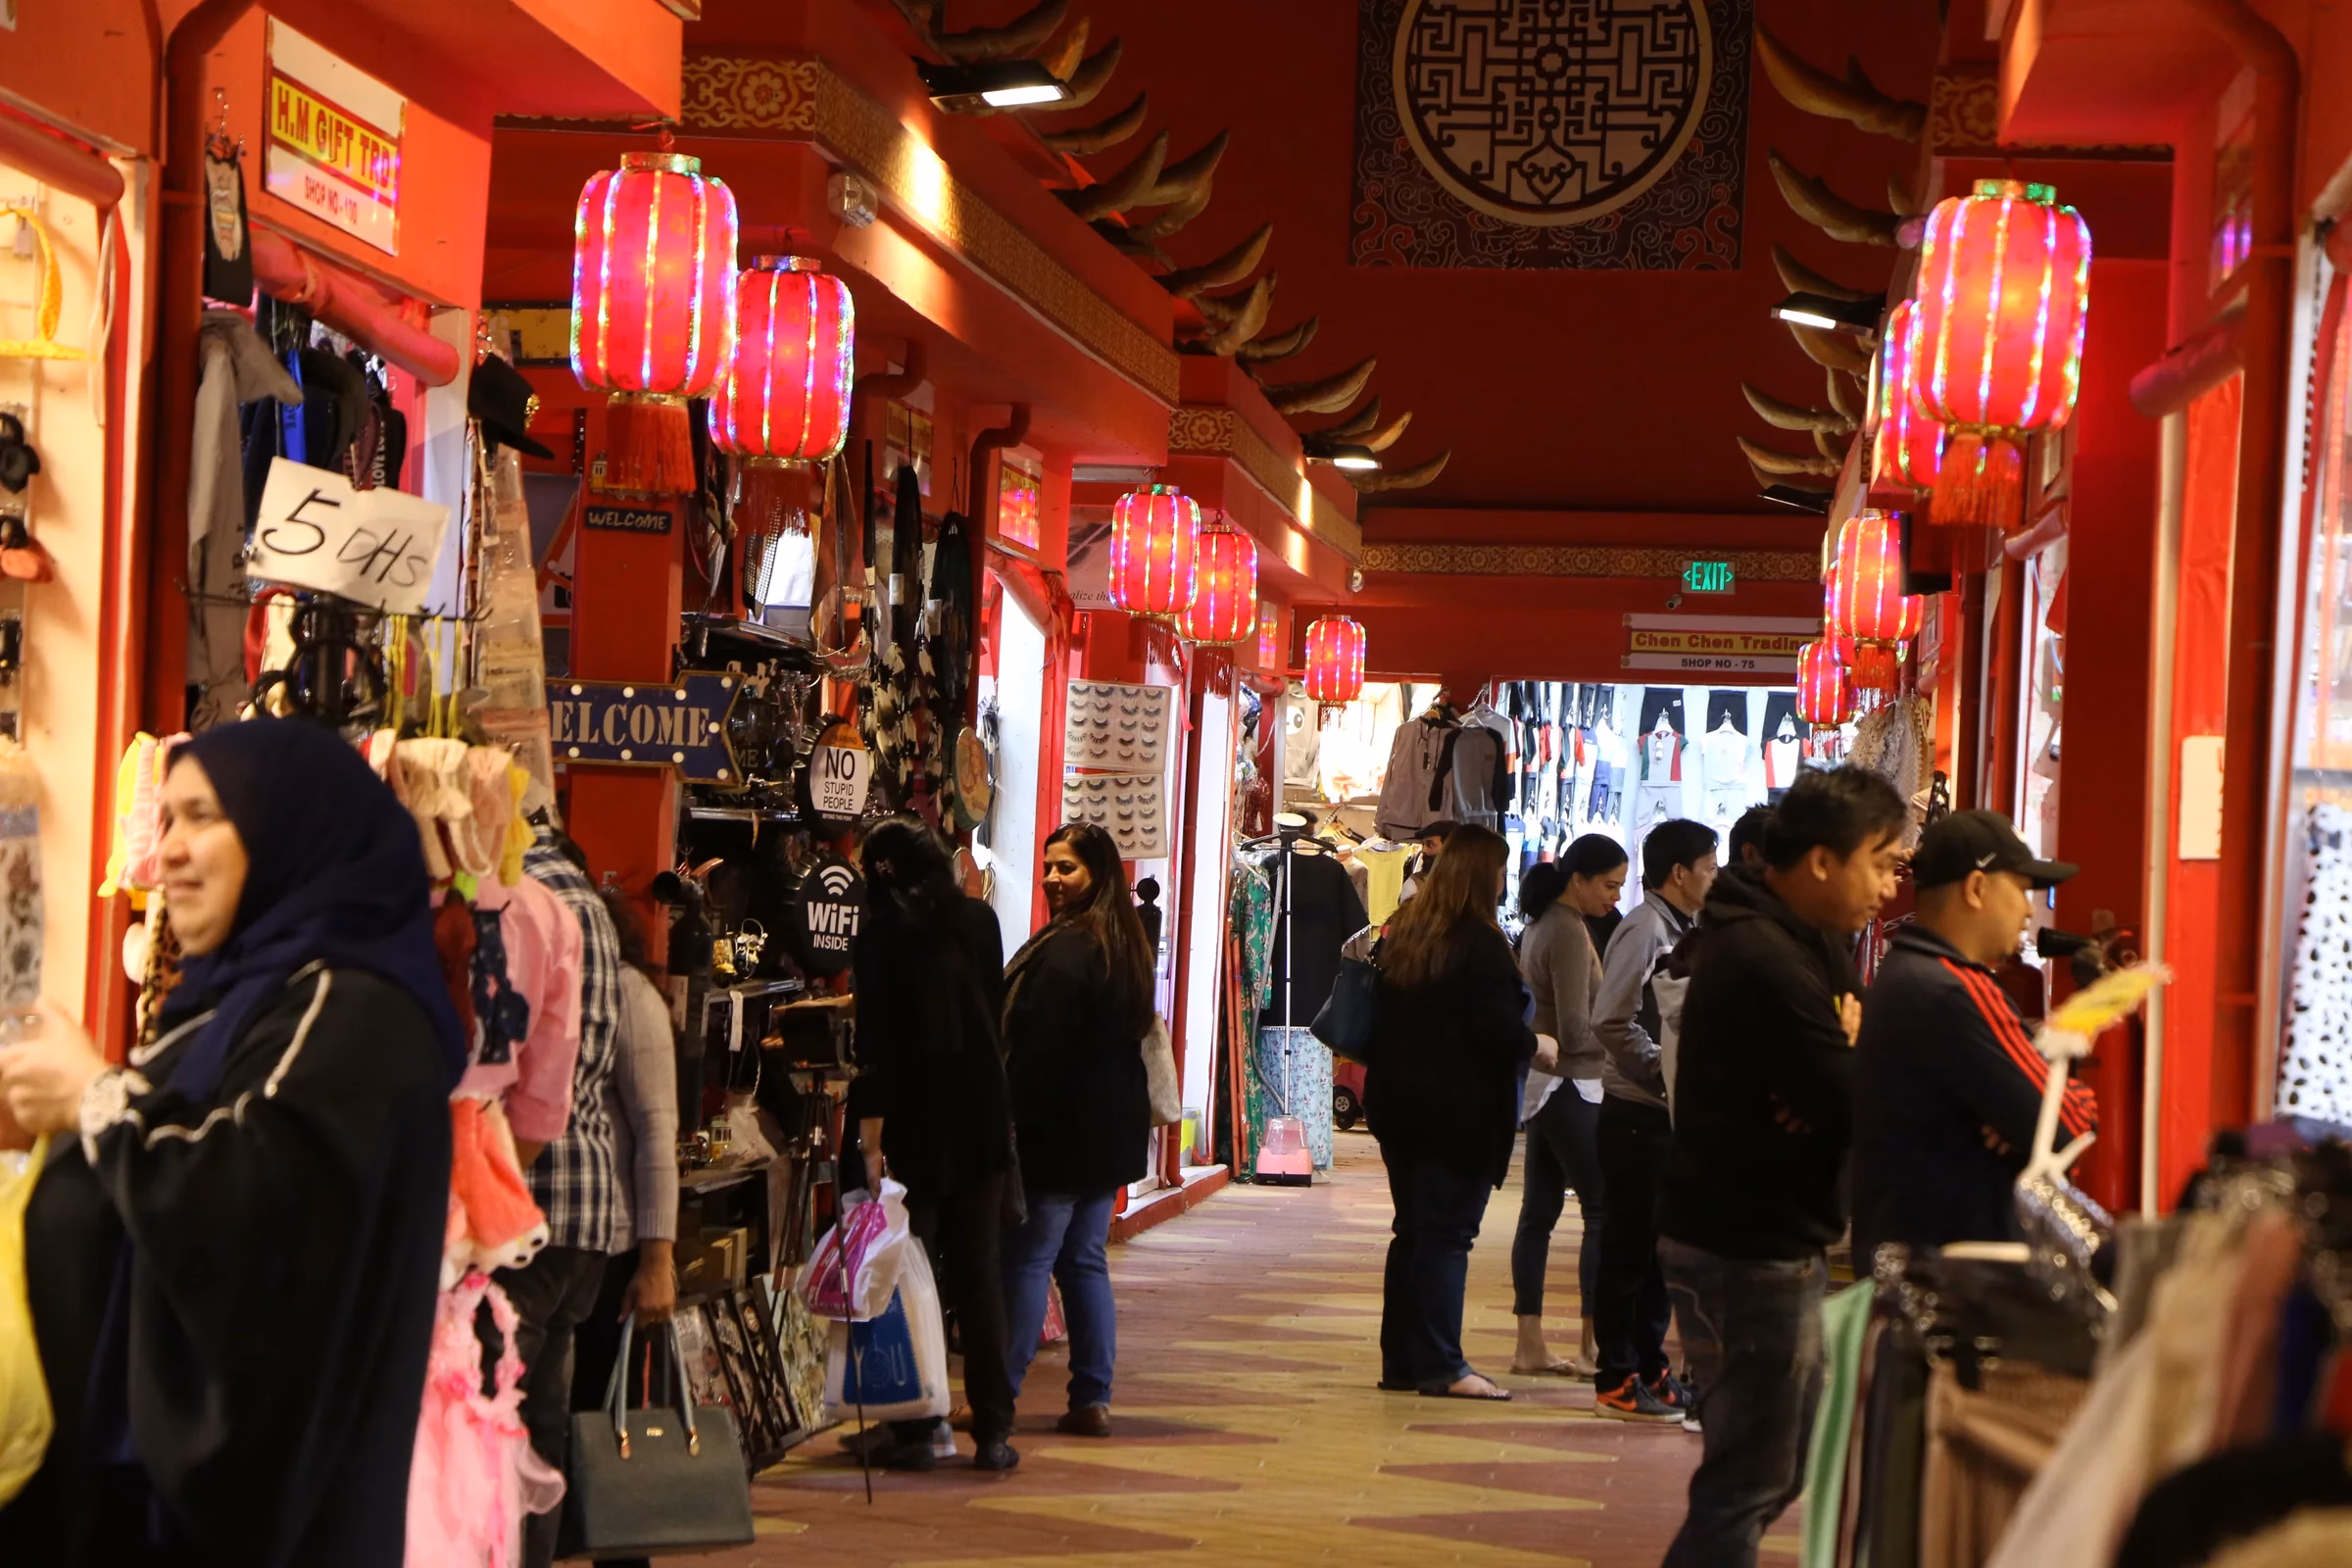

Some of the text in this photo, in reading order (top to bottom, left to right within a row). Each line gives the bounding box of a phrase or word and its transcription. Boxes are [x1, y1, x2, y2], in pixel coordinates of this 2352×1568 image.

[277, 84, 310, 144] H.M
[316, 109, 354, 168] GIFT
[305, 175, 326, 207] SHOP
[261, 488, 340, 556] 5
[1691, 562, 1728, 591] EXIT
[1681, 659, 1712, 668] SHOP
[1715, 660, 1732, 668] NO
[1741, 660, 1754, 669] 75
[551, 701, 710, 747] ELCOME
[825, 747, 856, 781] NO
[823, 796, 854, 810] PEOPLE
[824, 781, 854, 796] STUPID
[807, 902, 859, 936] WiFi
[812, 934, 849, 951] INSIDE
